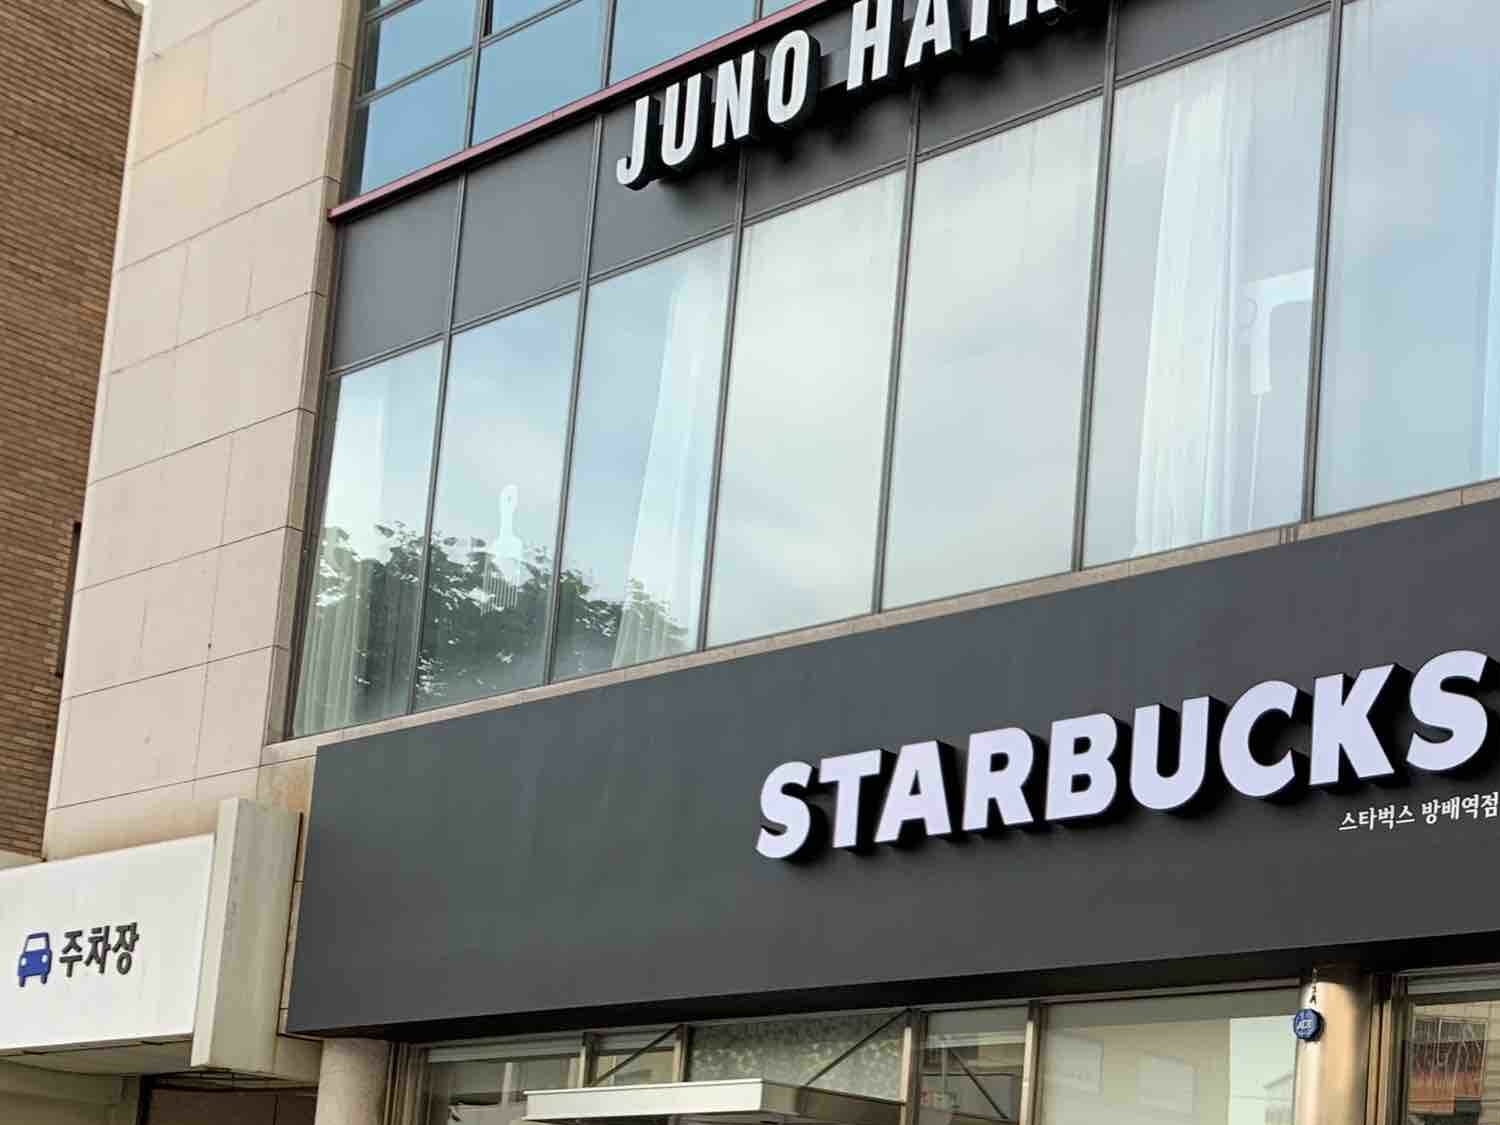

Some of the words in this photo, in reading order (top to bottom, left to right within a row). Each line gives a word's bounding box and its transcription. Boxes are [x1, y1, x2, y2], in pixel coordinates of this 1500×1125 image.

[616, 29, 812, 189] JUNO
[756, 650, 1491, 861] STARBUCKS
[1338, 804, 1416, 831] 스타벅스
[1421, 791, 1500, 825] 방배역점
[58, 922, 140, 978] 주차장
